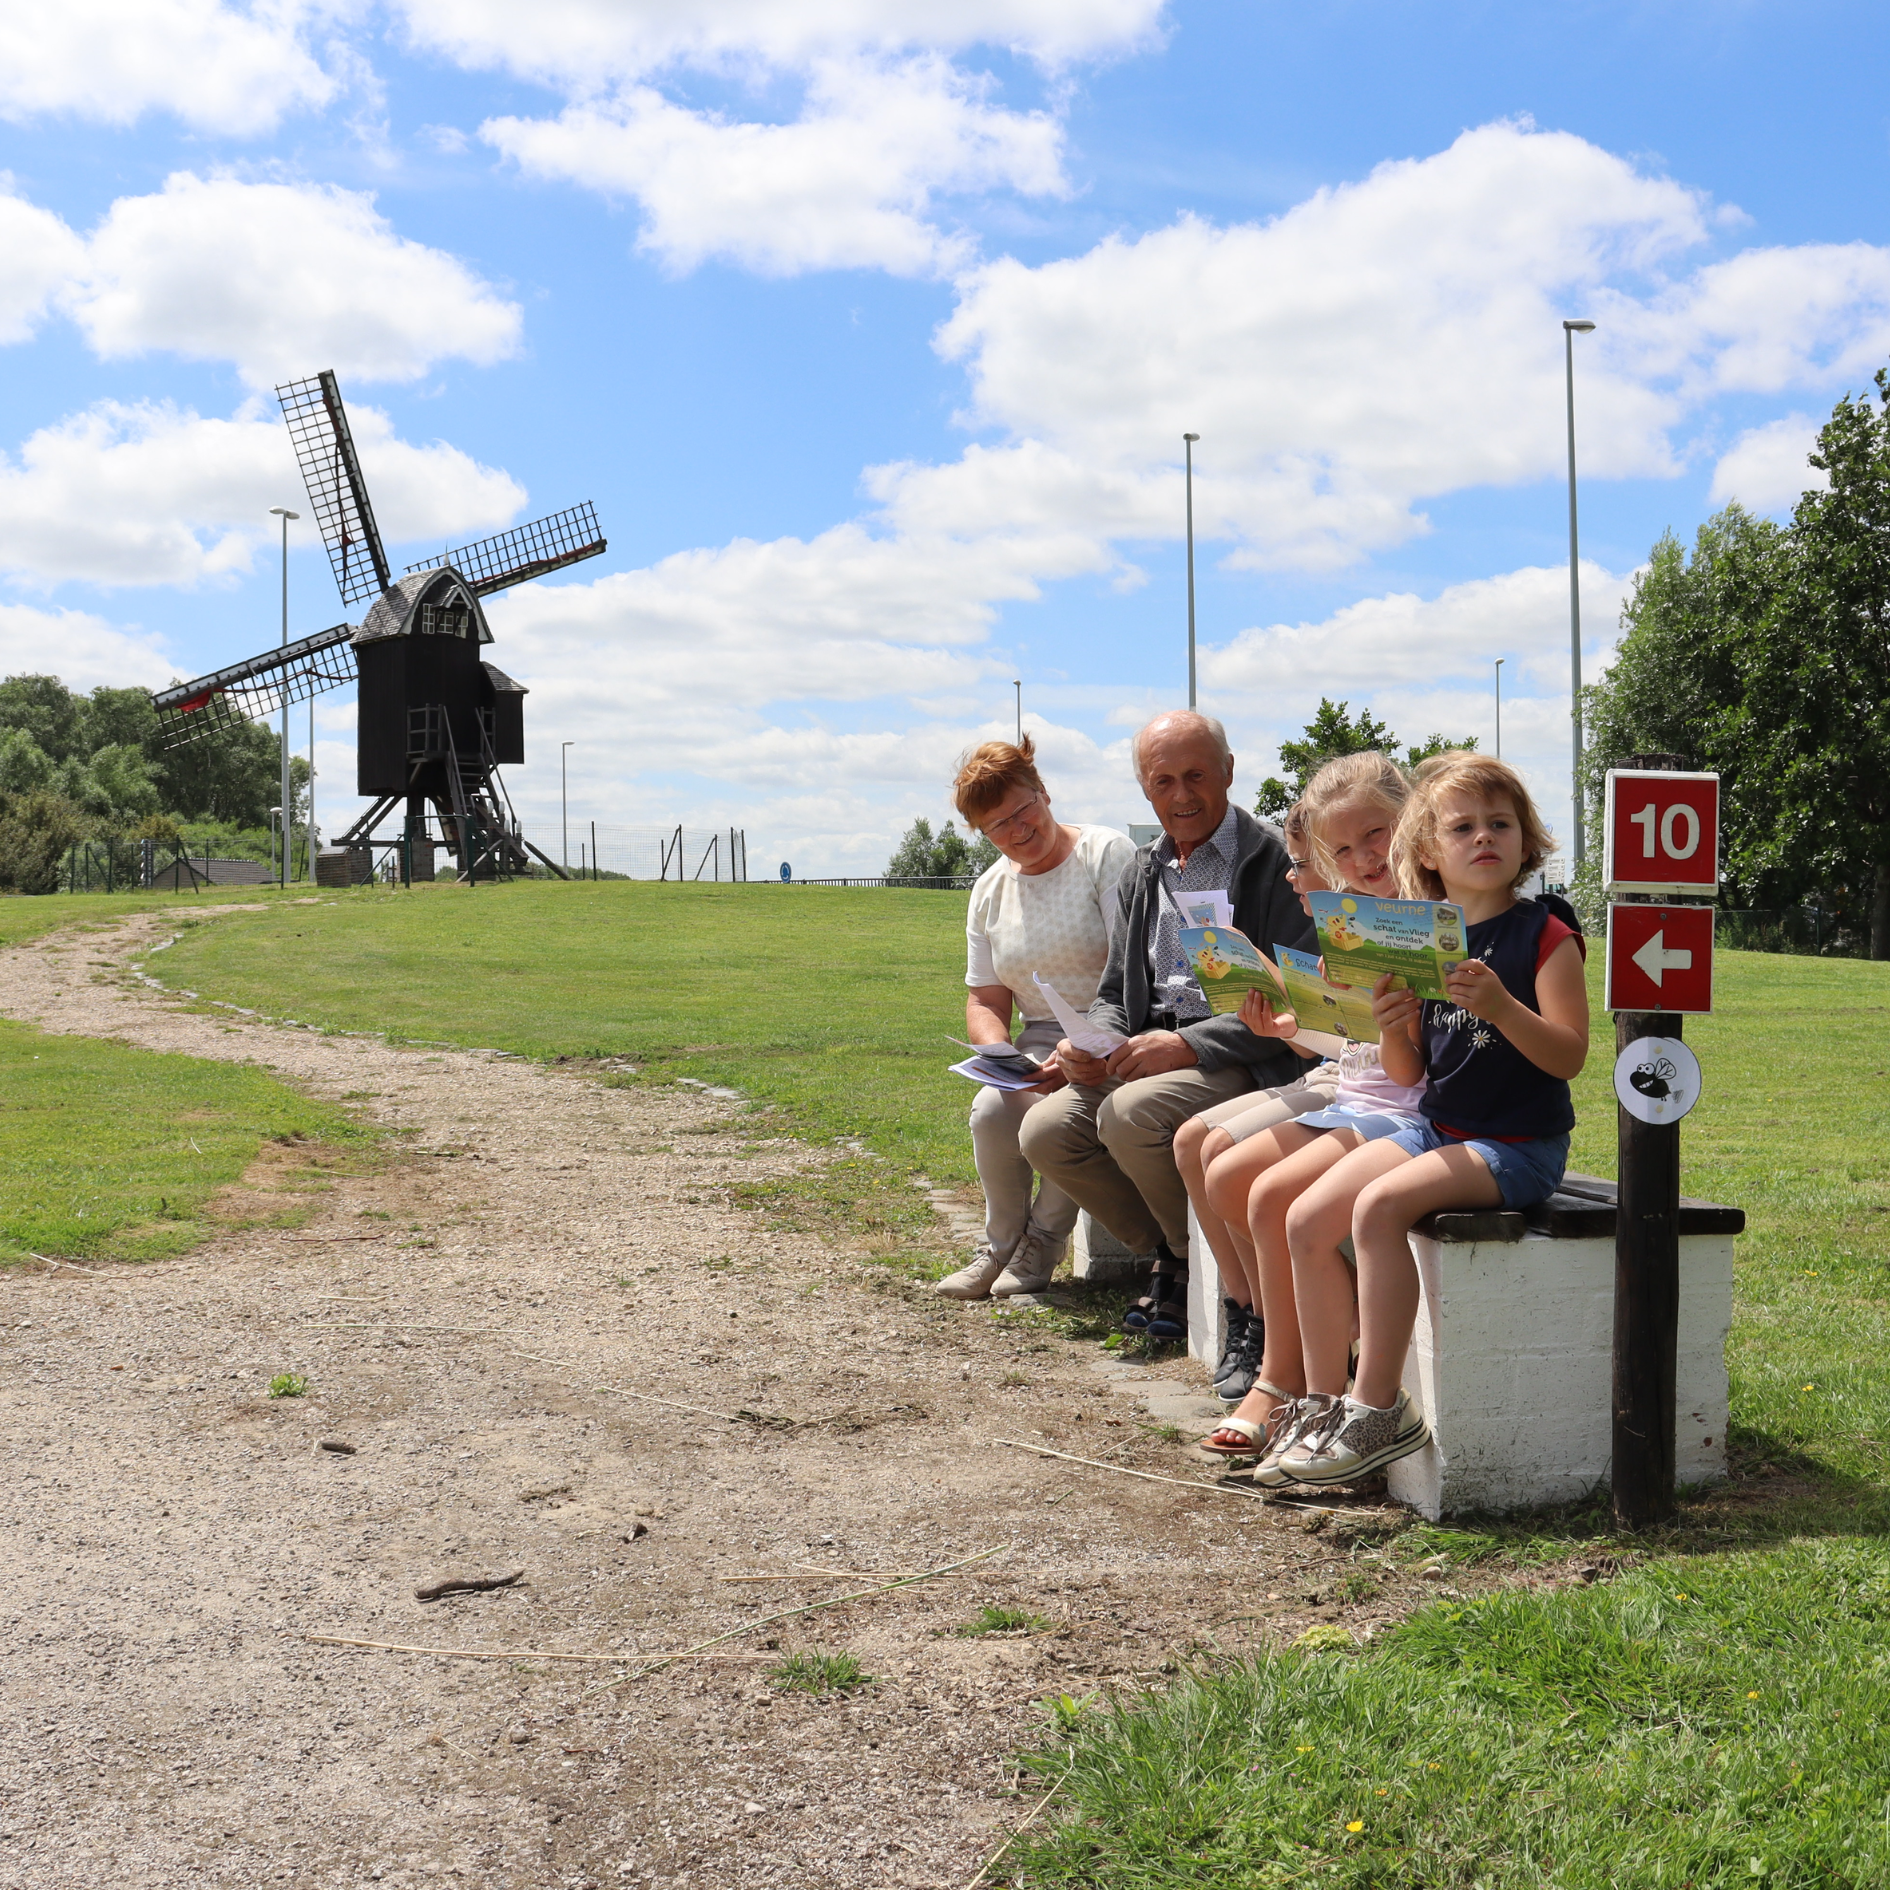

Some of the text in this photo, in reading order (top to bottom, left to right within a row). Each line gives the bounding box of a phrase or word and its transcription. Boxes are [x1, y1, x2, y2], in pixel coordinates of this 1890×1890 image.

[1630, 803, 1700, 860] 10
[1375, 902, 1426, 915] veurne
[1374, 924, 1397, 933] schat
[1409, 929, 1430, 938] Vlieg
[1396, 935, 1424, 944] ontdek
[1433, 1003, 1479, 1034] happy
